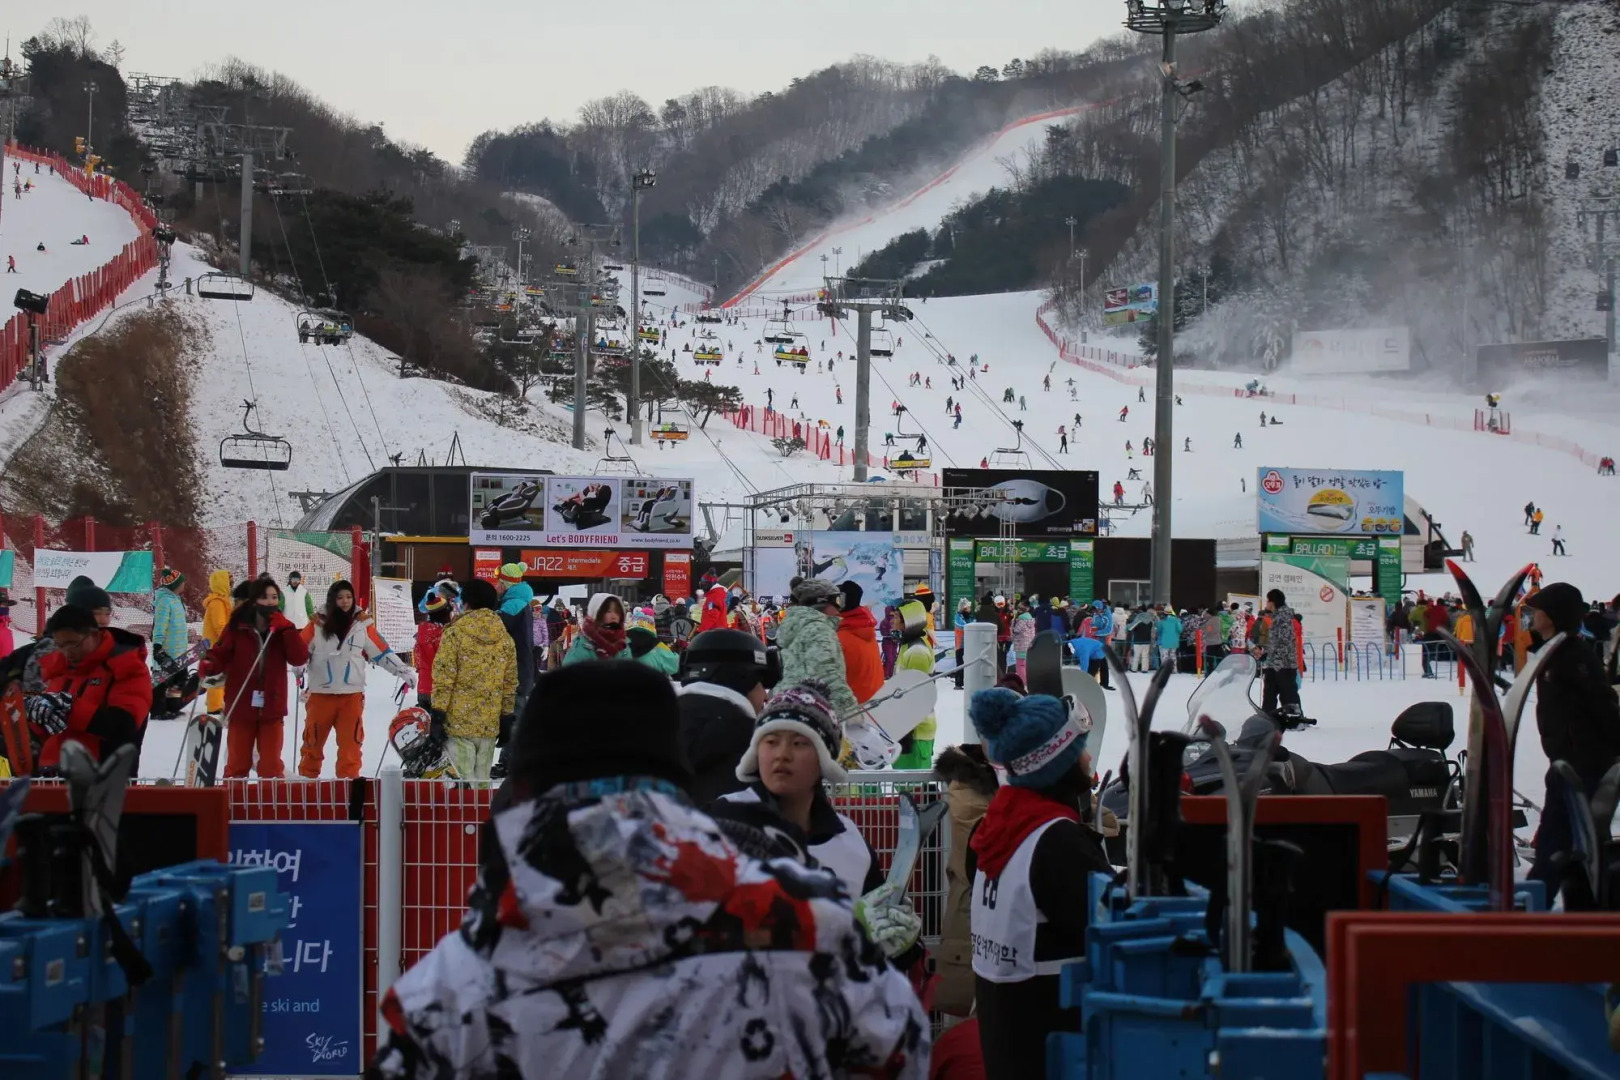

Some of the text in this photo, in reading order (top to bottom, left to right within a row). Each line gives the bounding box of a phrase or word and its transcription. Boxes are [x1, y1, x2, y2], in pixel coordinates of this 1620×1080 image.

[499, 534, 531, 542] 1600-2225
[546, 534, 618, 545] Let's BODYFRIEND
[980, 546, 1018, 558] BALLAD
[1046, 545, 1068, 558] 초급
[1296, 543, 1330, 554] BALLAD
[1355, 542, 1376, 556] 초급
[529, 556, 563, 571] JAZZ
[618, 556, 645, 573] 중급
[1409, 788, 1438, 798] YAMAHA
[270, 998, 290, 1012] ski
[292, 998, 320, 1012] and
